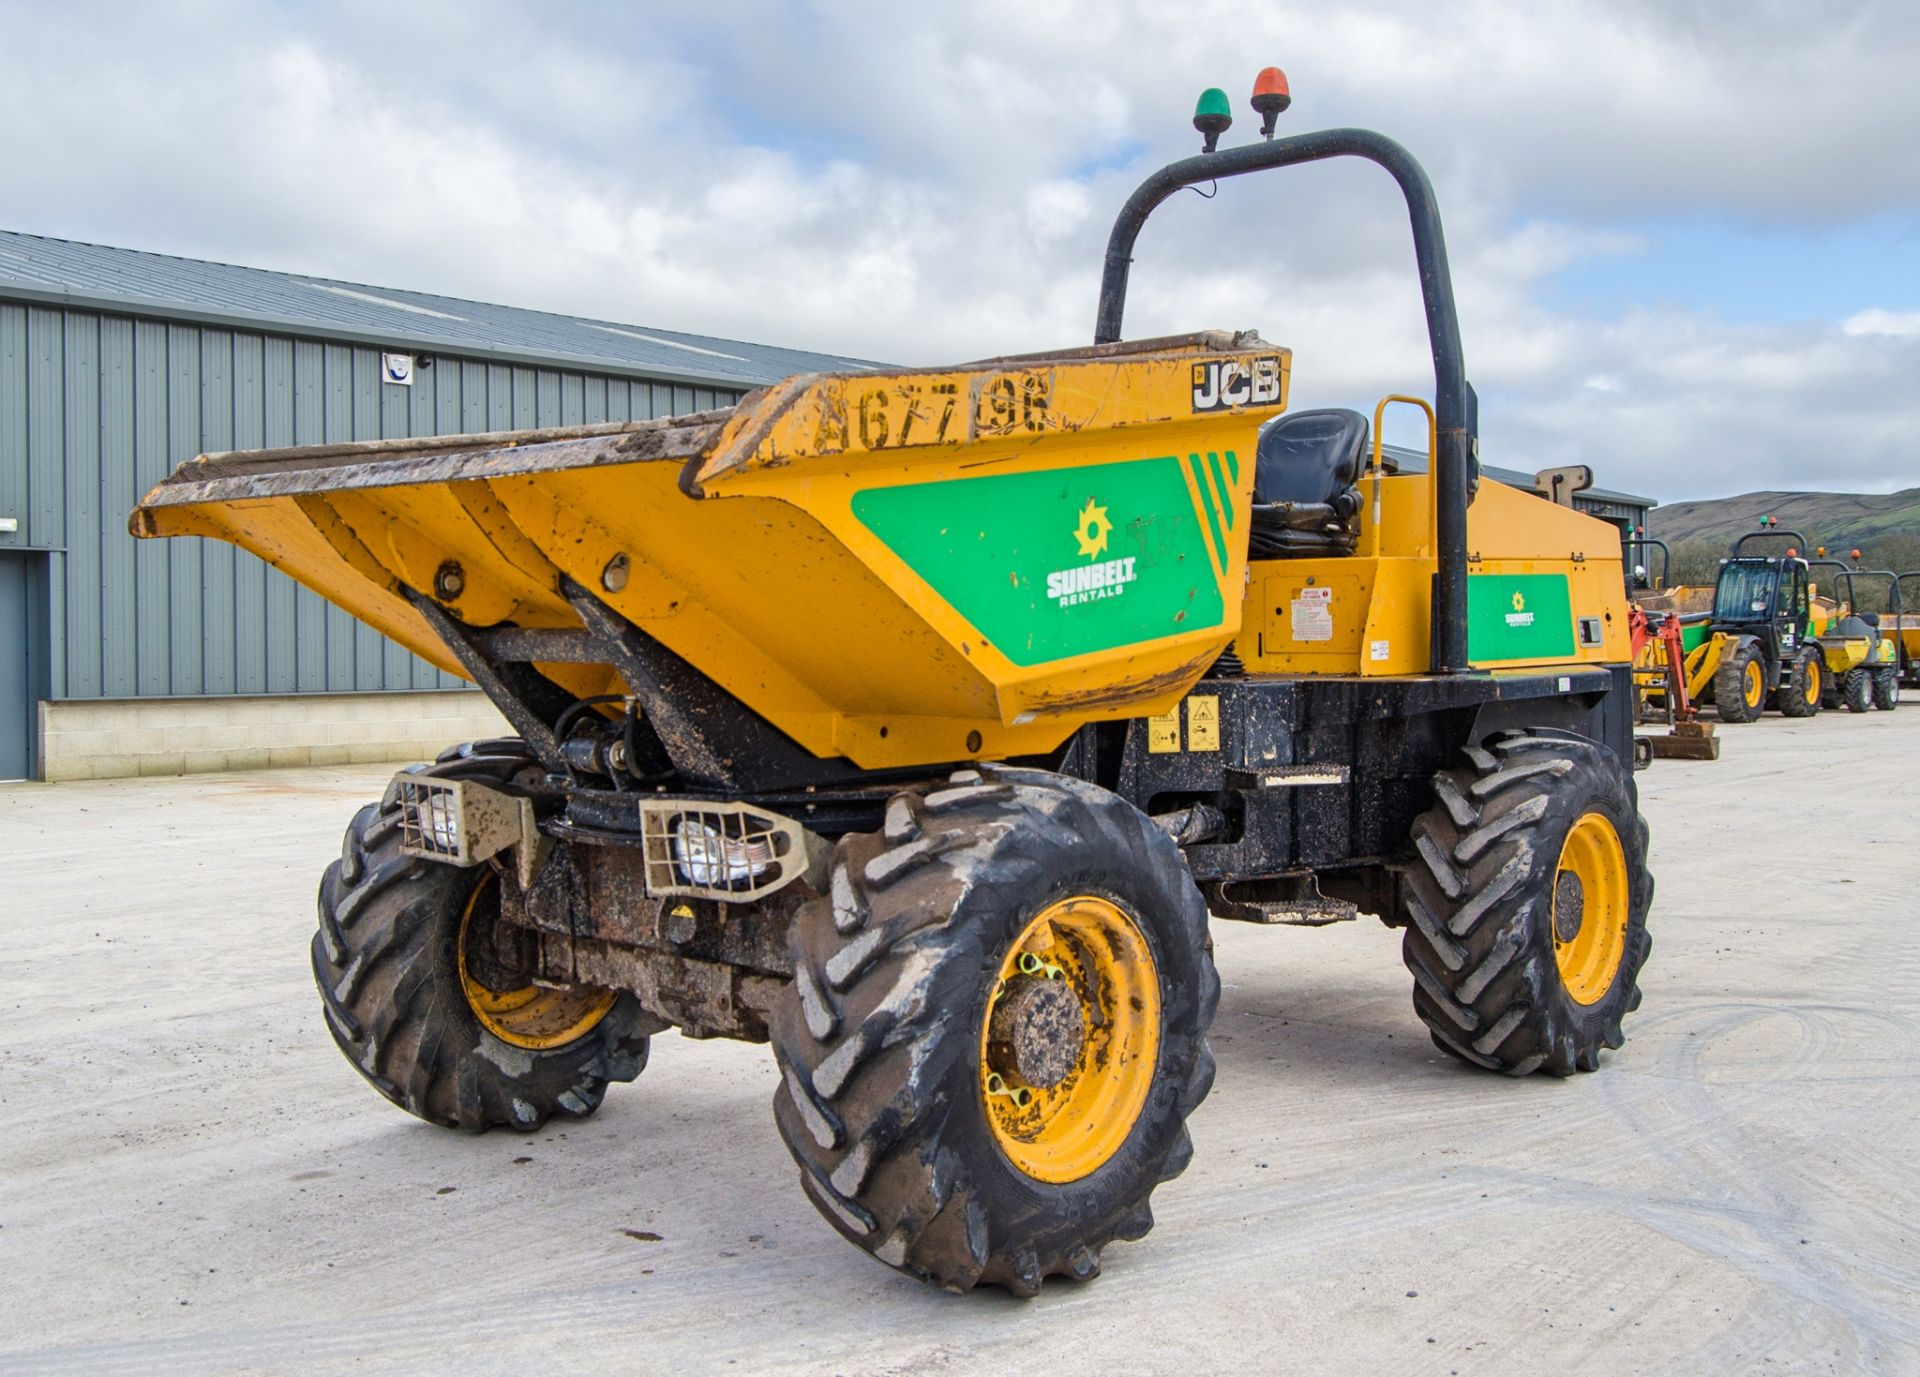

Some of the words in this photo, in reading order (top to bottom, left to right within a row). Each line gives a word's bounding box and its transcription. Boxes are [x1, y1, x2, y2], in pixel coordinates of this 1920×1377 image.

[1194, 360, 1281, 409] JCB
[1046, 556, 1137, 599] SUNBELT
[1060, 584, 1124, 608] RENTALS
